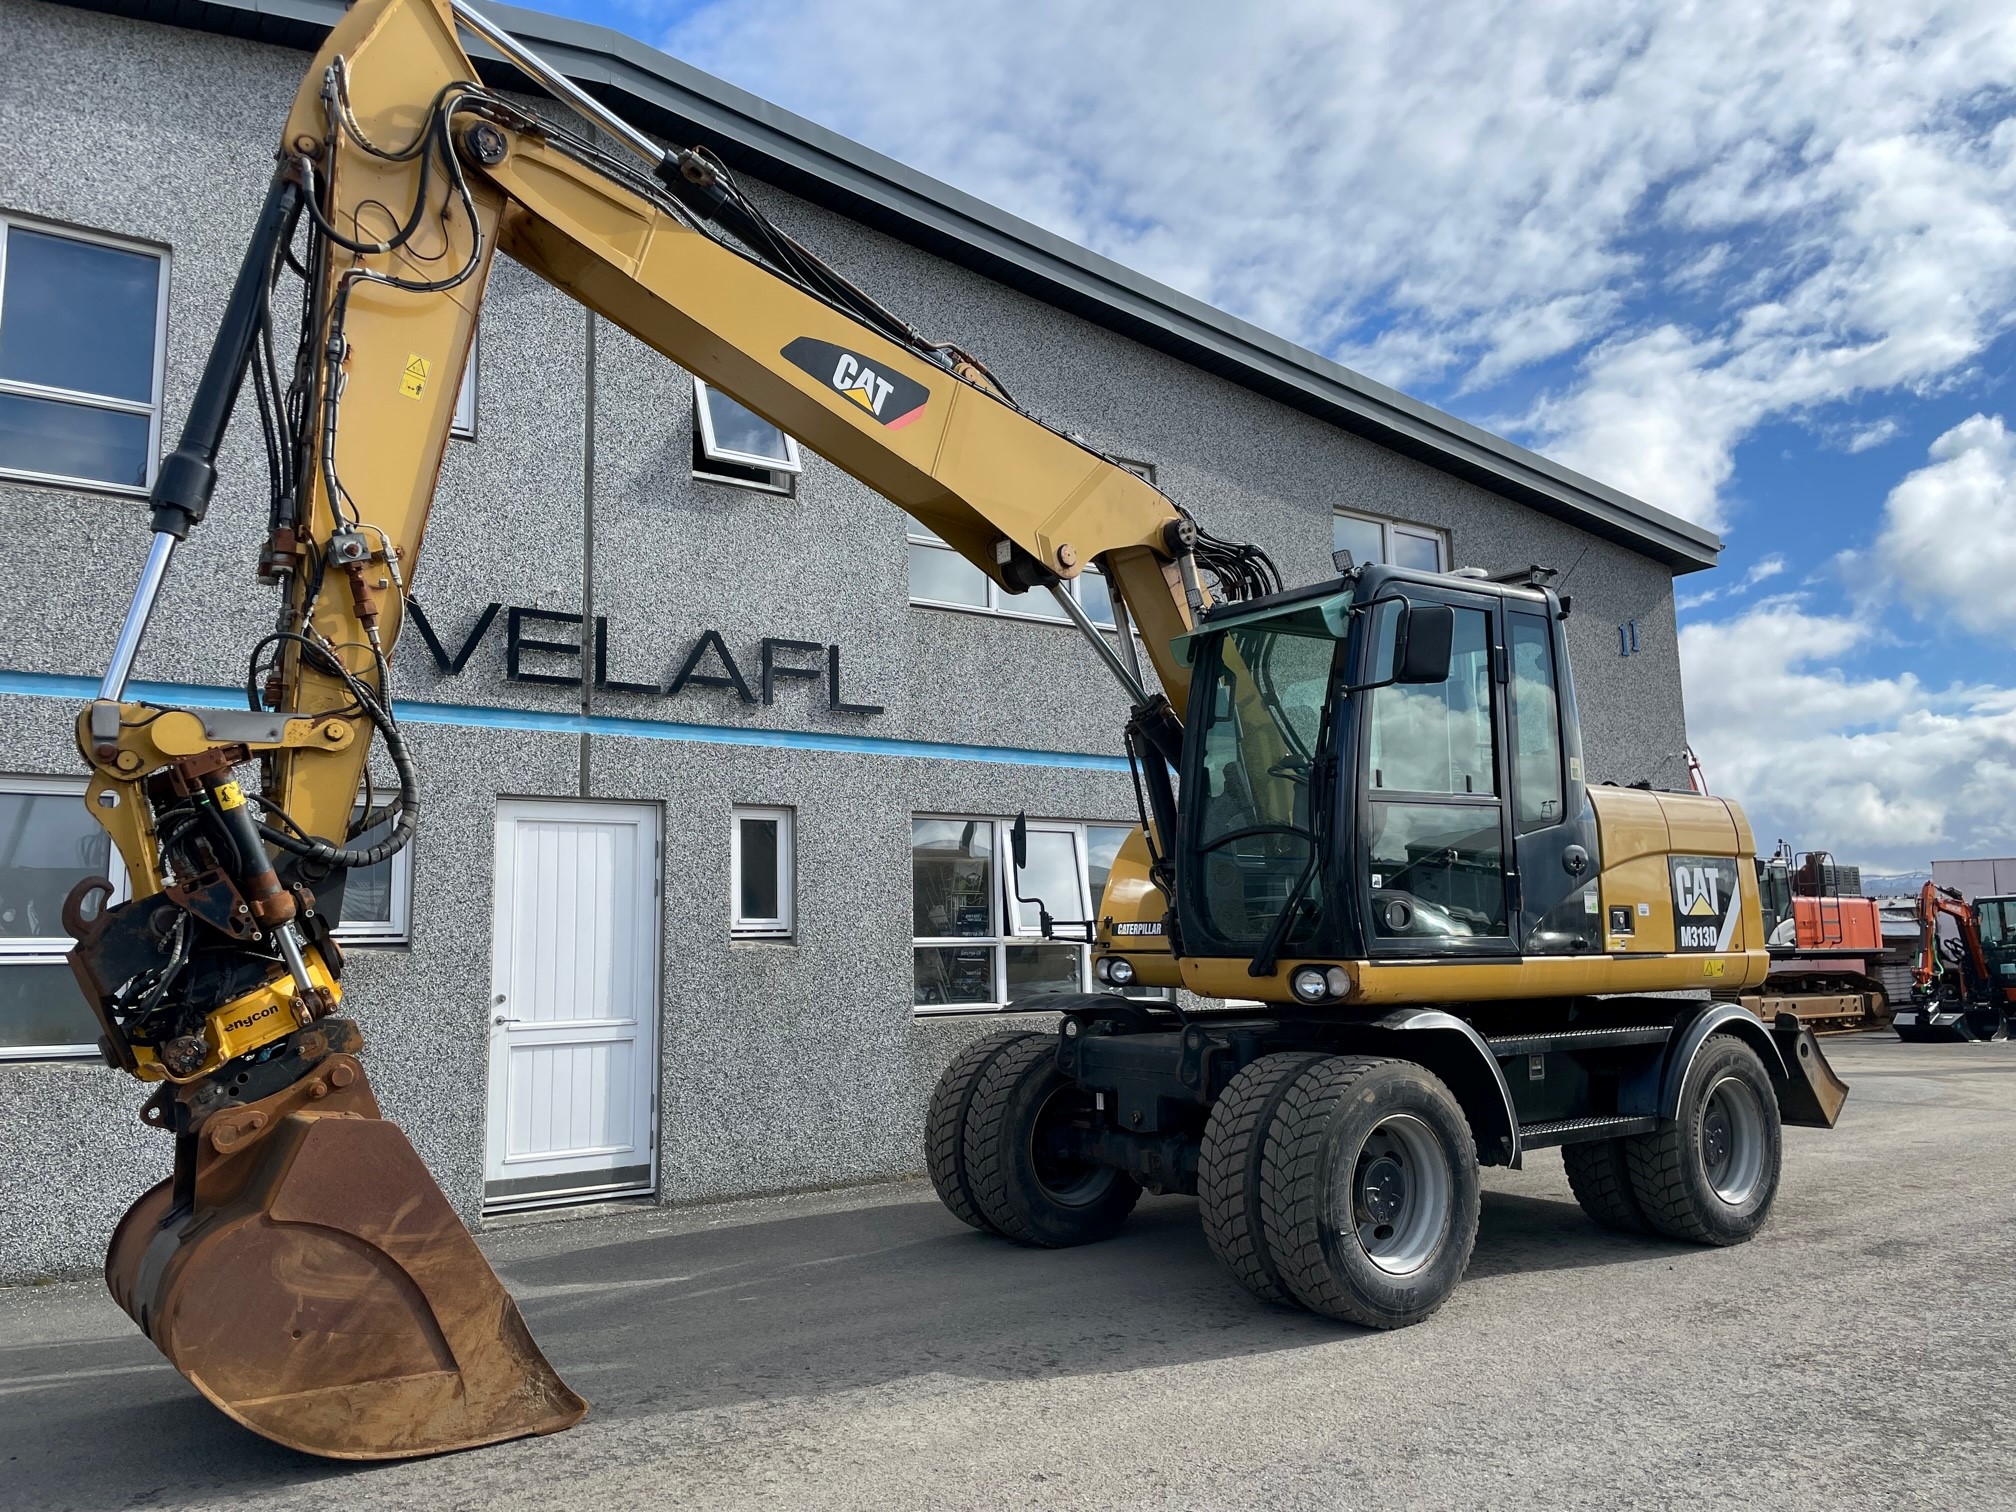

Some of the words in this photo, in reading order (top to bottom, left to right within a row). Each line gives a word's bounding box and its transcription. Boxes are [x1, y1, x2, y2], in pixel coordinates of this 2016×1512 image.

[832, 353, 894, 416] CAT
[406, 594, 885, 714] VELAFL
[1618, 619, 1640, 657] 11
[1675, 866, 1719, 916] CAT
[1117, 923, 1162, 935] CATERPILLAR
[1680, 926, 1718, 948] M313D
[224, 1004, 279, 1032] engcon
